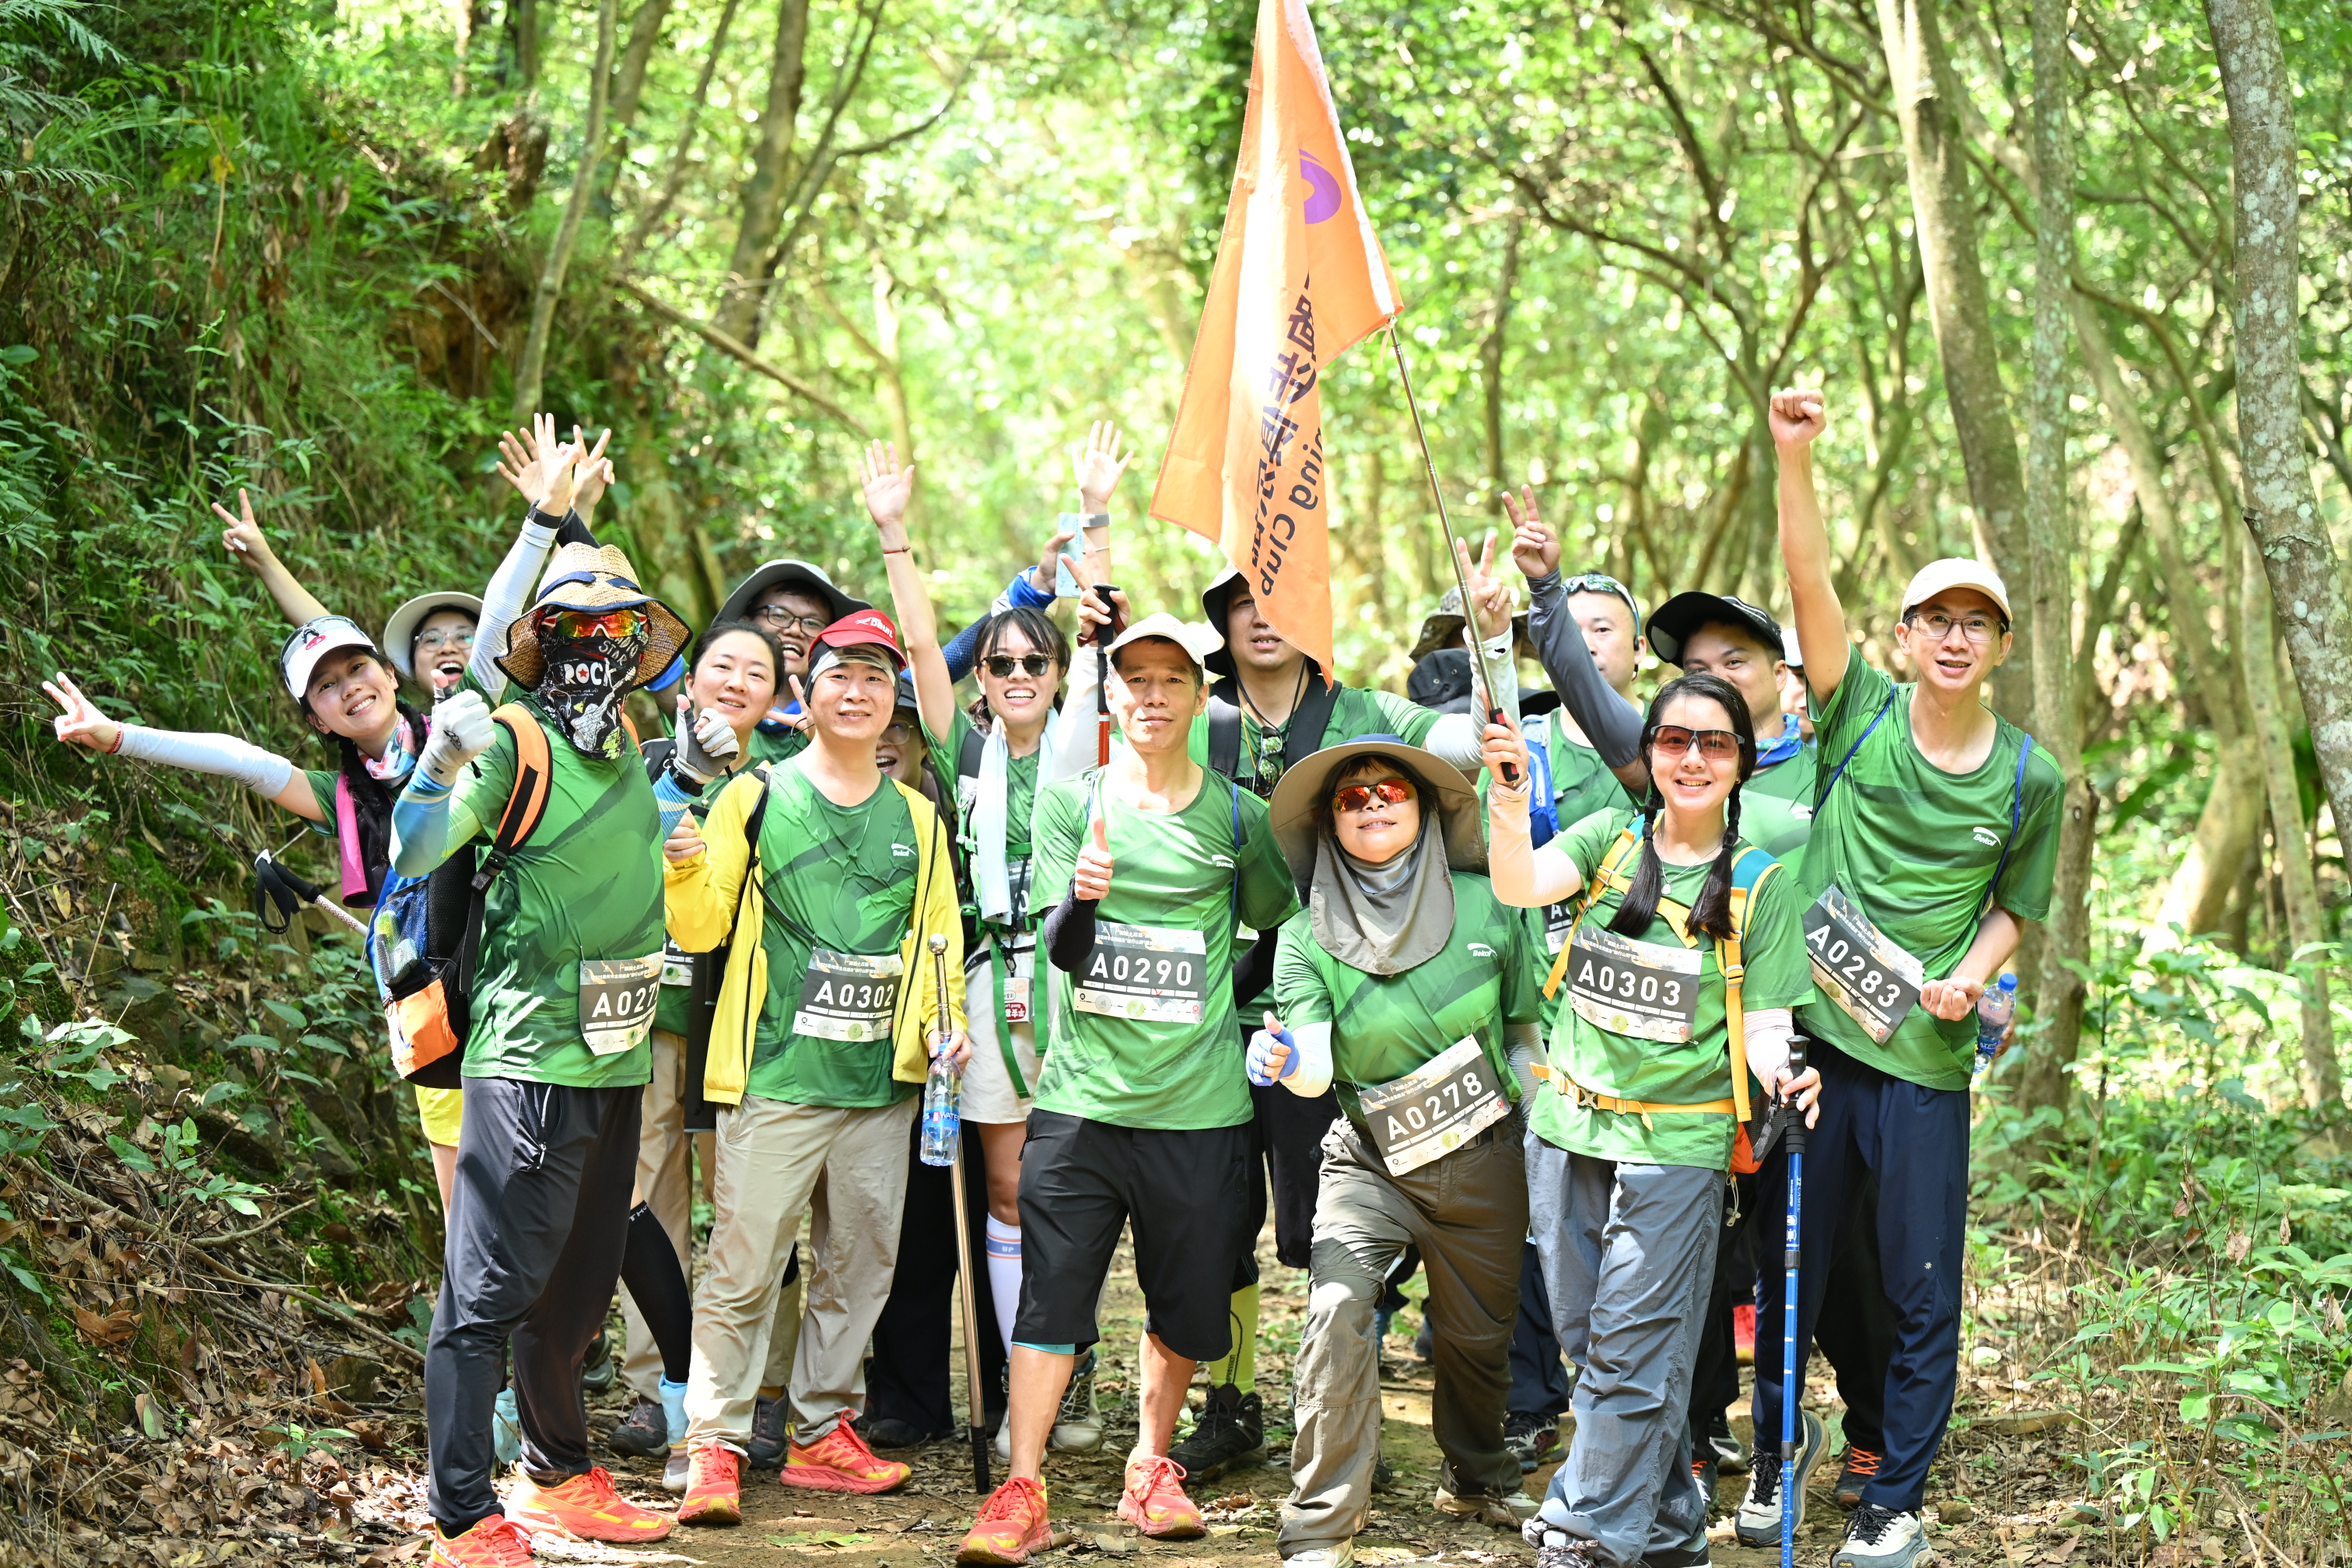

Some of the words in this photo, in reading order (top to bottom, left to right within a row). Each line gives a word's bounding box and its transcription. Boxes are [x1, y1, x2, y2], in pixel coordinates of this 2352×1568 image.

[564, 658, 616, 688] ROCK
[1090, 953, 1192, 986] A0290
[1806, 924, 1901, 1007] A0283
[814, 980, 894, 1009] A0302
[1578, 959, 1681, 1006] A0303
[940, 1111, 959, 1121] WATE
[1388, 1072, 1482, 1141] A0278
